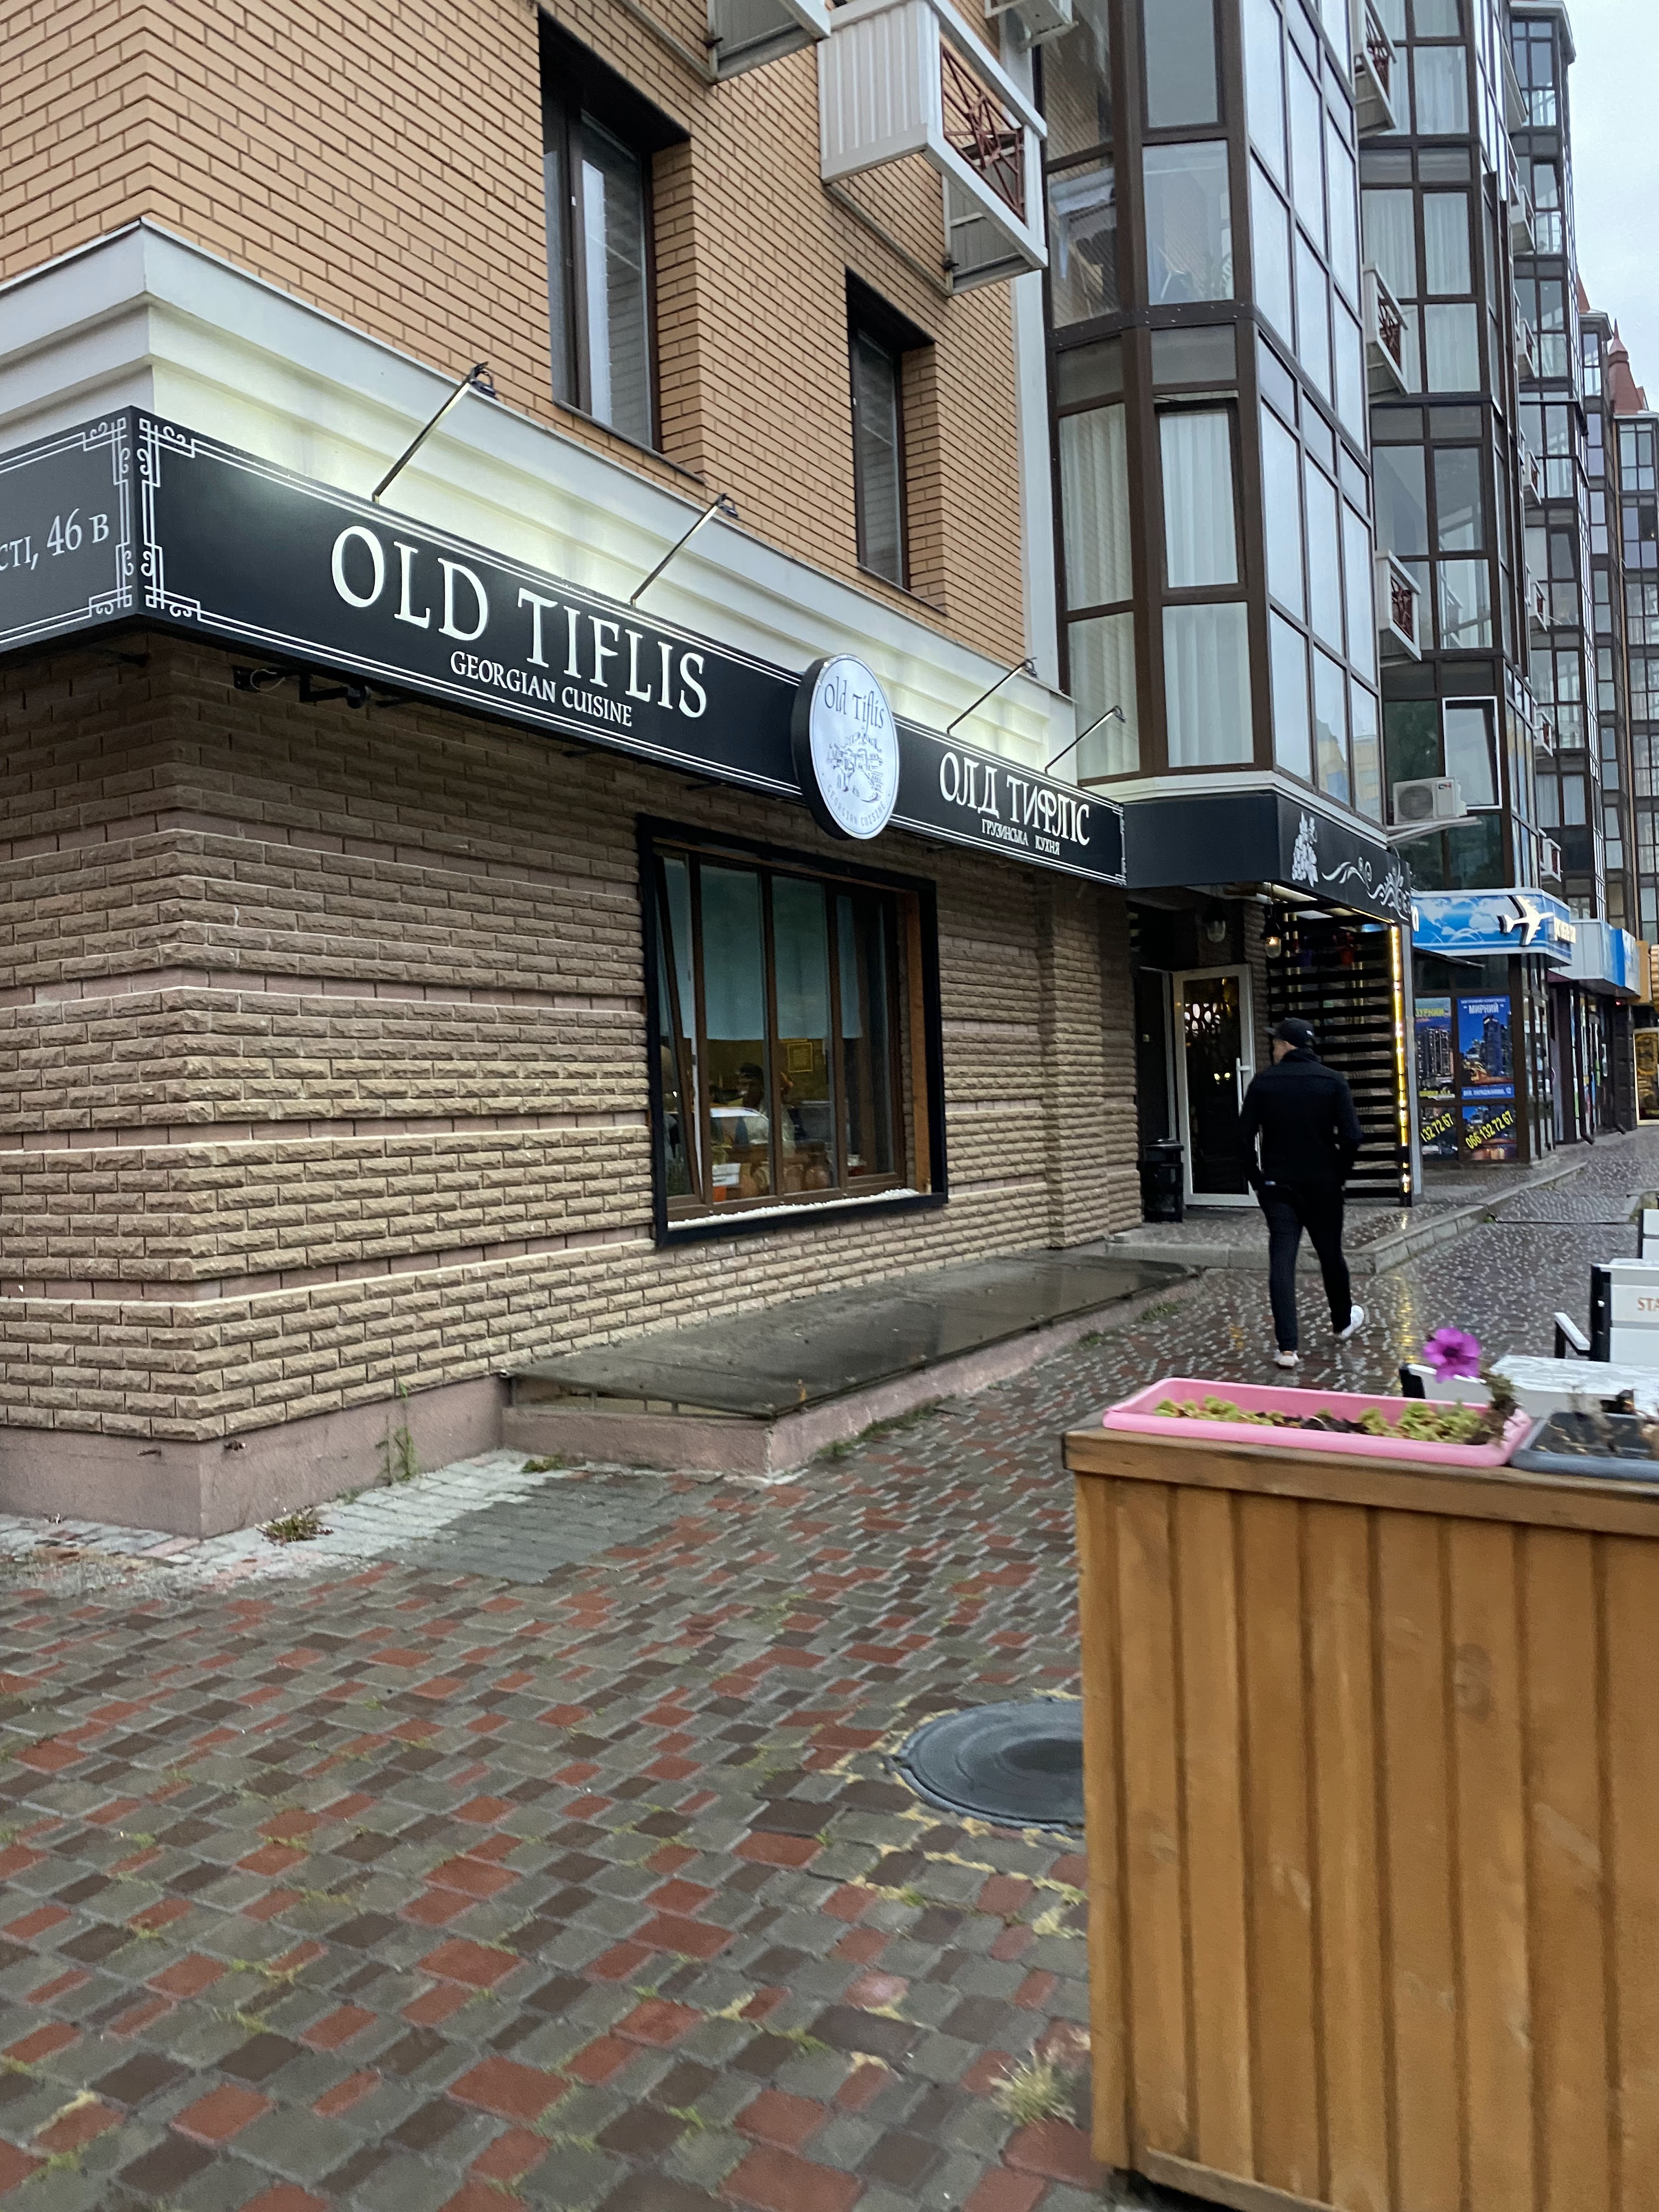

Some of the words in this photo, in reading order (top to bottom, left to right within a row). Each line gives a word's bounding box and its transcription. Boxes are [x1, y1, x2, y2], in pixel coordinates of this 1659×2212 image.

[47, 508, 82, 556] 46
[331, 525, 488, 641] OLD
[517, 586, 707, 718] TIFLIS
[450, 651, 556, 703] GEORGIAN
[562, 687, 632, 727] CUISINE
[825, 676, 847, 715] Old
[852, 690, 884, 737] Tiflis
[827, 785, 857, 826] GEORGIAN
[861, 800, 887, 827] CUISINE
[940, 752, 1000, 819] ОЛД
[1006, 775, 1090, 846] ТИФЛІС
[981, 819, 1029, 847] ГРУЗИНСЬКА
[1035, 835, 1060, 856] КУХНЯ
[1432, 1120, 1445, 1134] 72
[1441, 1113, 1454, 1127] 67
[1465, 1132, 1482, 1149] 066
[1479, 1124, 1496, 1140] 132
[1491, 1117, 1505, 1132] 72
[1502, 1110, 1514, 1125] 67
